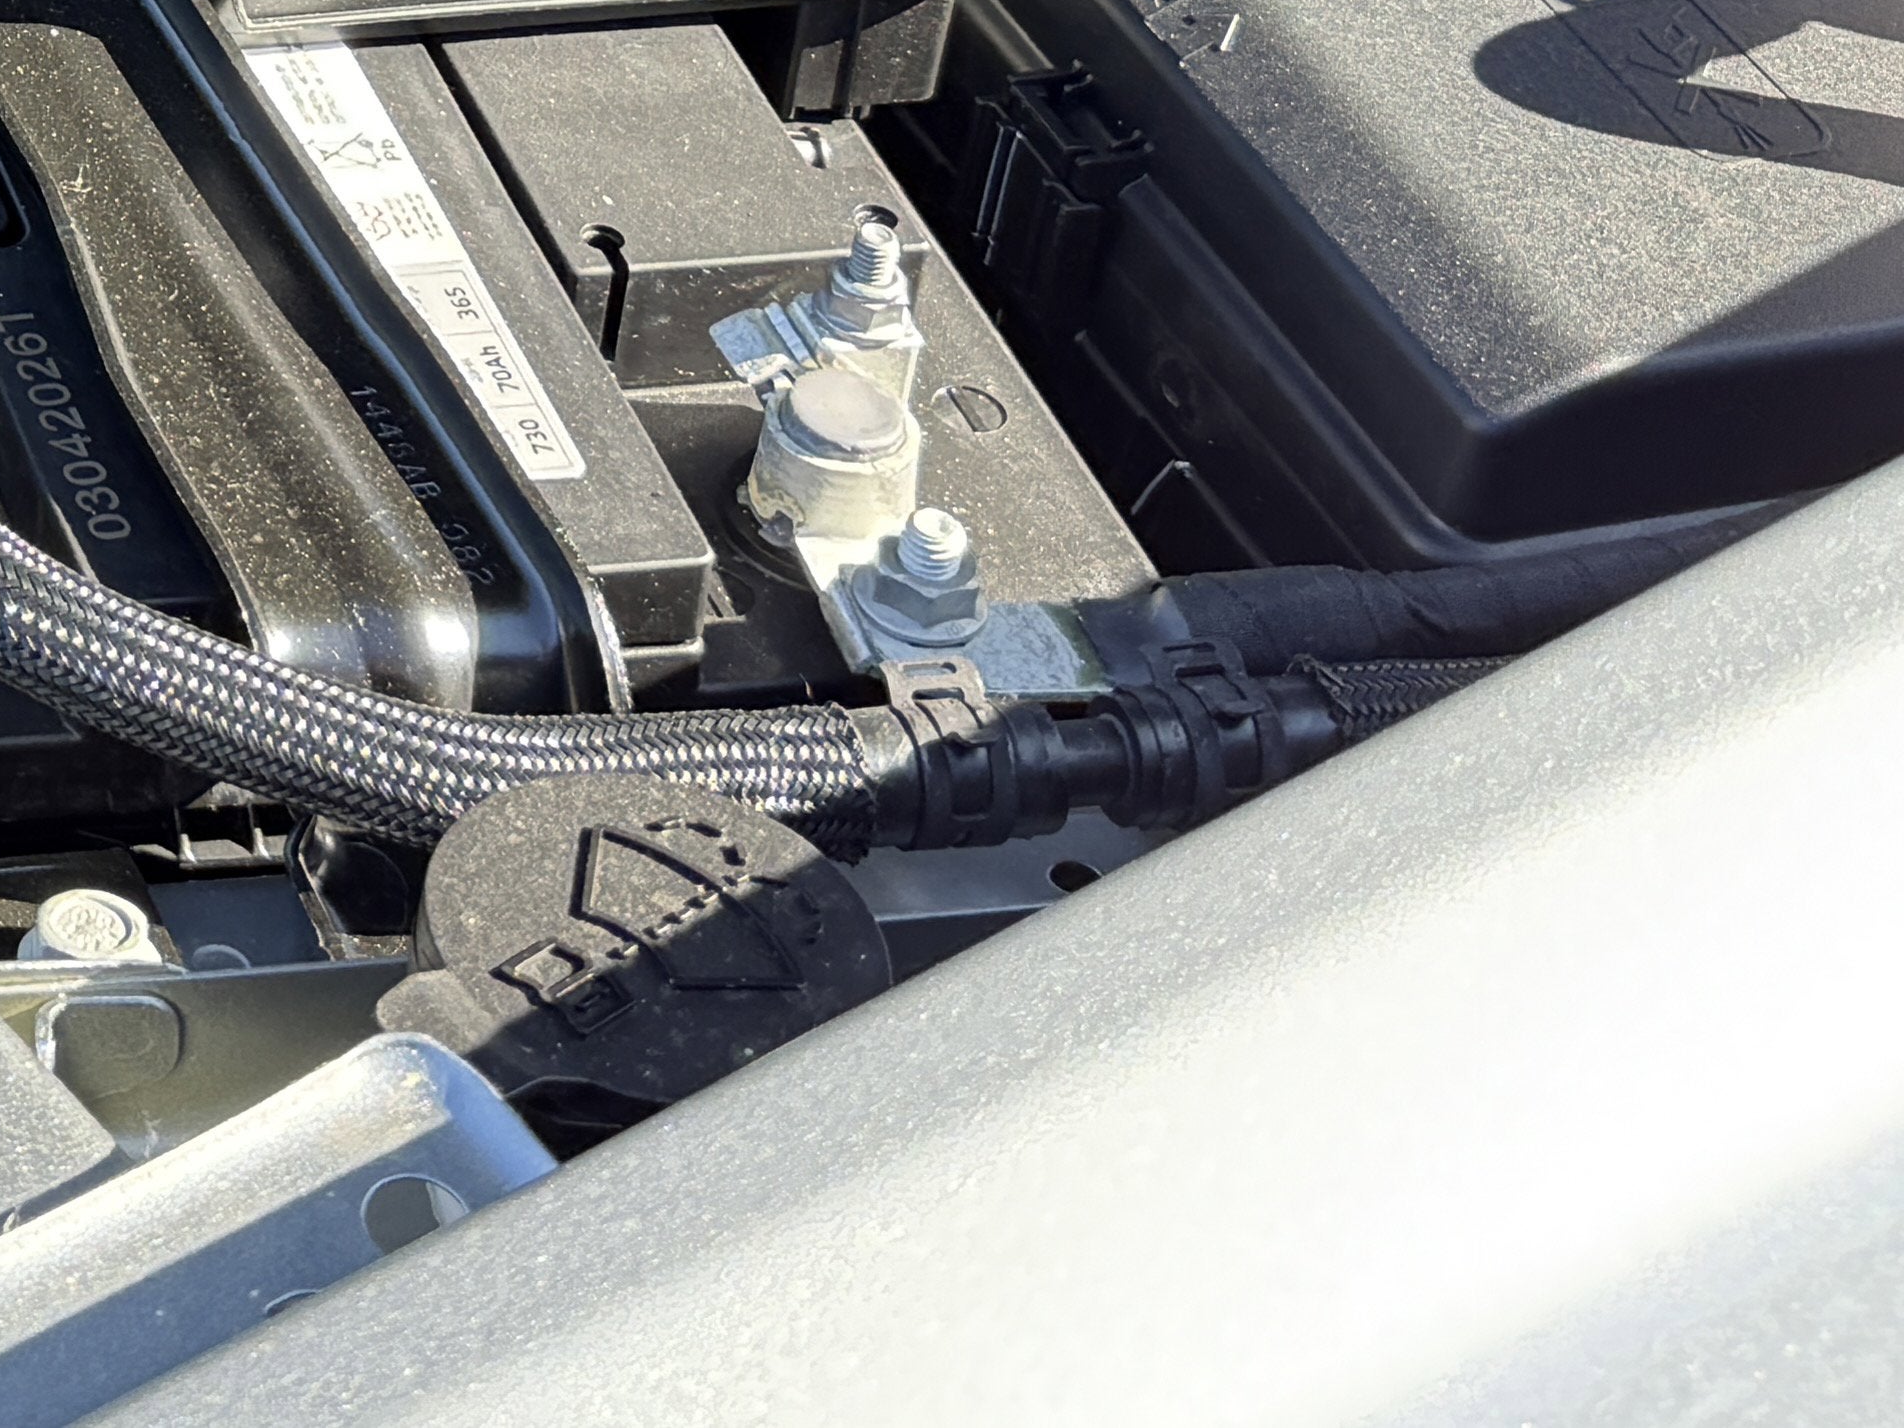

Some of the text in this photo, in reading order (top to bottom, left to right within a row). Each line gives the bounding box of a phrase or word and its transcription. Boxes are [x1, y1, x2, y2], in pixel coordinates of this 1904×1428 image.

[444, 287, 480, 320] 365
[479, 344, 521, 394] 70Ah
[518, 418, 555, 455] 730
